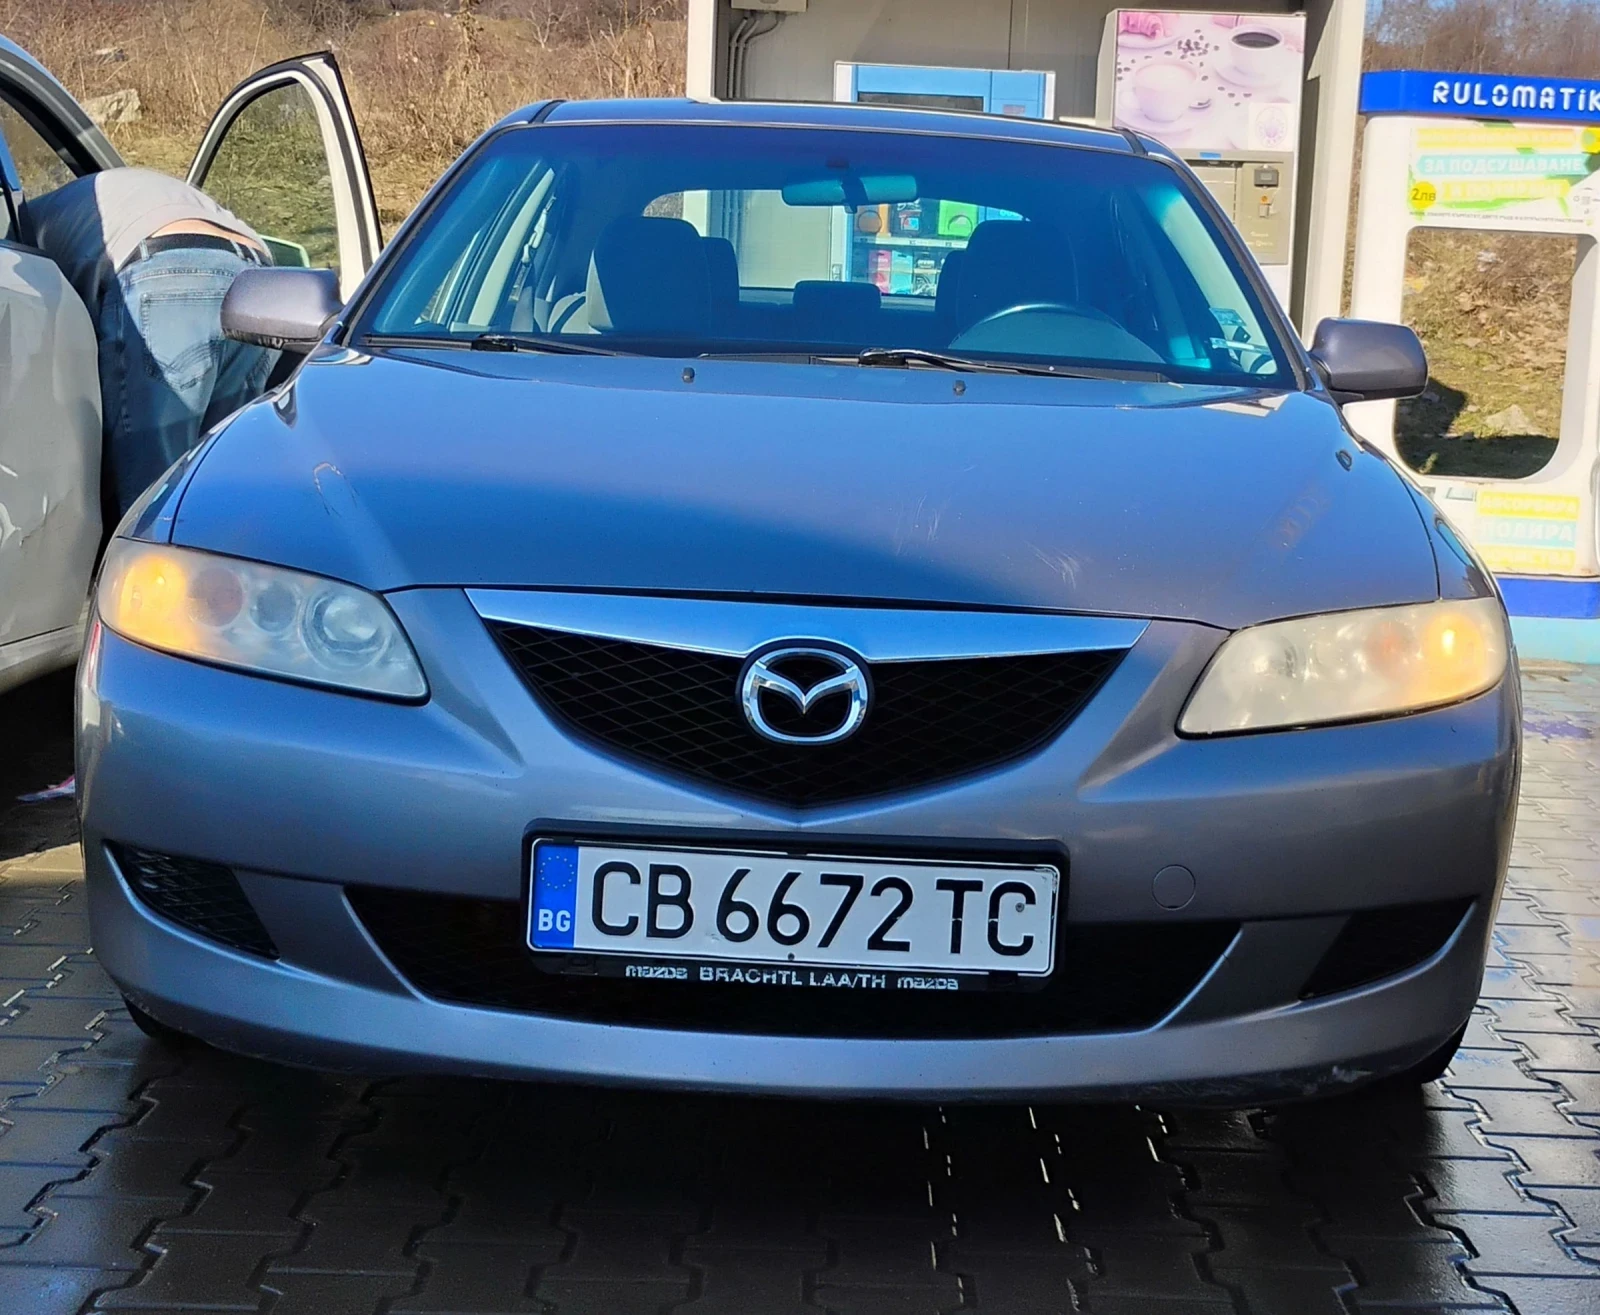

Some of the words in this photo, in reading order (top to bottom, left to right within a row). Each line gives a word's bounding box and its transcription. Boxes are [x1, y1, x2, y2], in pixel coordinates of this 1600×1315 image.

[1424, 159, 1446, 173] ЗА
[1449, 158, 1583, 174] ПОДСУШАВАНЕ
[1480, 520, 1573, 543] ПОЛИРА
[537, 908, 571, 933] BG
[592, 861, 694, 939] CB
[716, 868, 914, 953] 6672
[935, 878, 1037, 957] TC
[699, 967, 803, 986] BRACHTL
